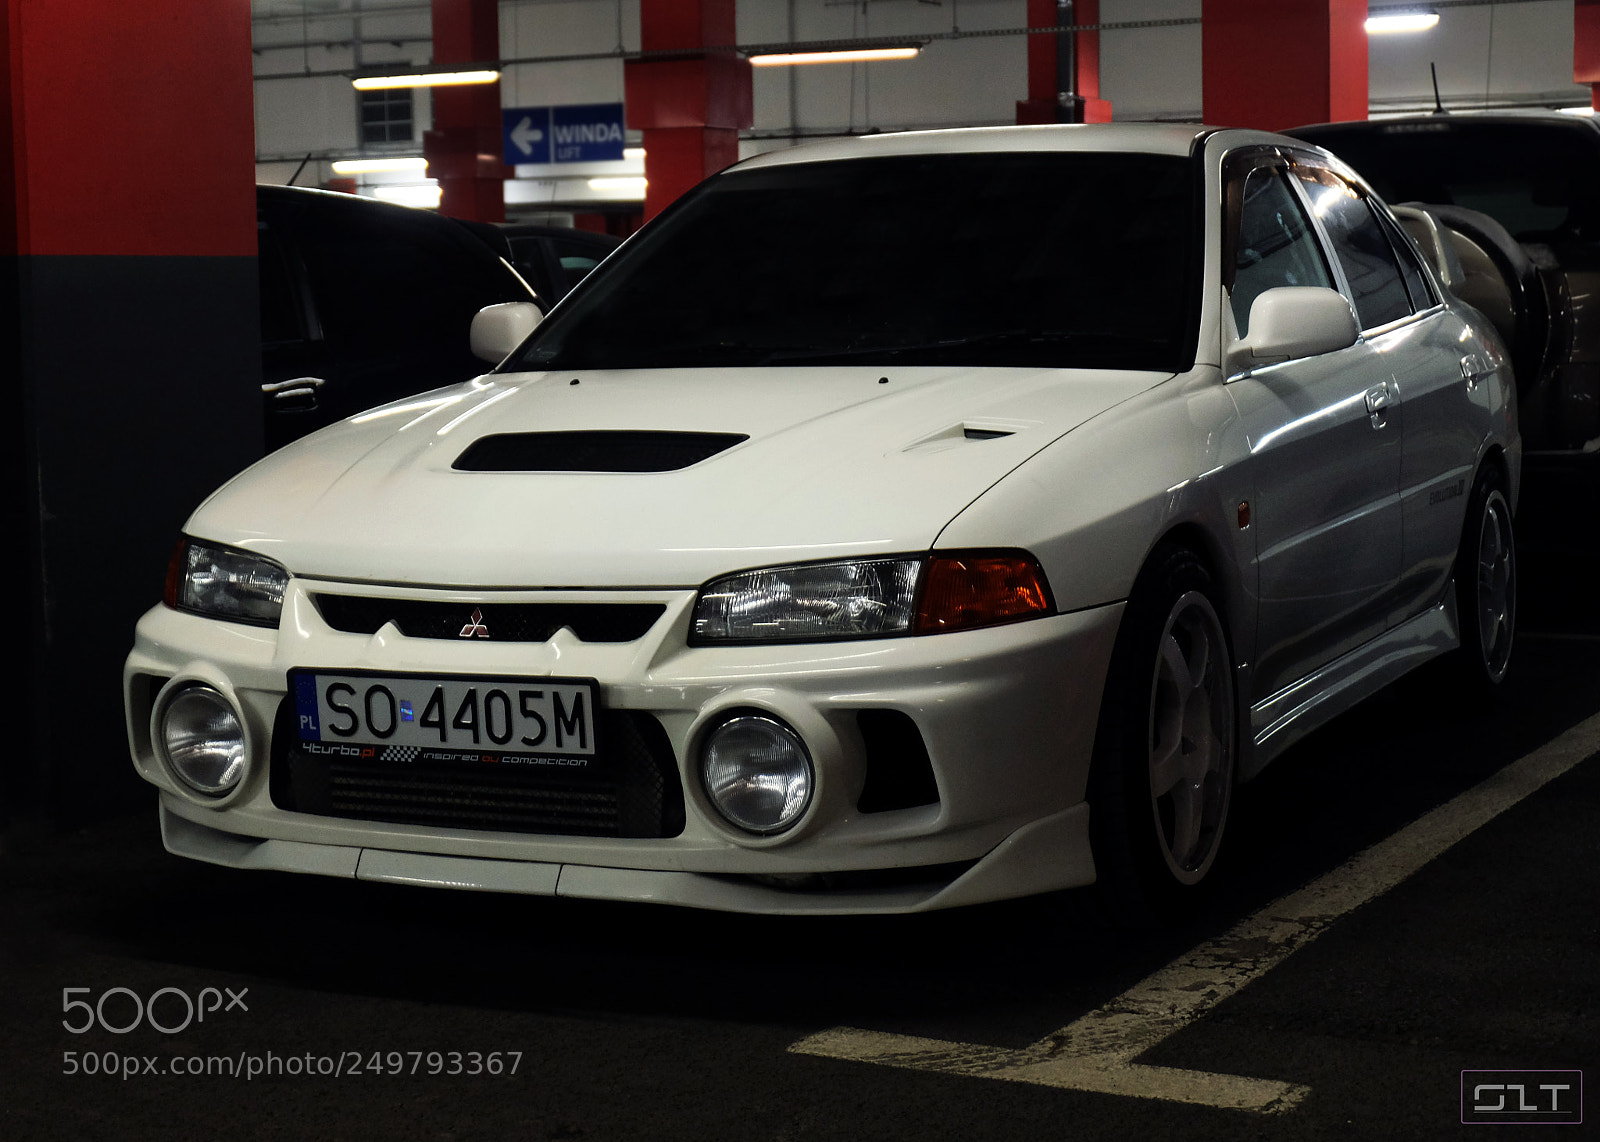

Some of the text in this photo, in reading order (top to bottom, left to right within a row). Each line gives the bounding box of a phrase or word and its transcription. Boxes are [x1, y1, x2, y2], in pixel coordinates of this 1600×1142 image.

[554, 122, 622, 144] WINDA
[558, 146, 581, 159] LIFT
[300, 714, 317, 731] PL
[325, 682, 588, 749] SO 4405M
[302, 741, 375, 760] 4turbo.pl
[423, 752, 479, 763] inspired
[502, 756, 588, 767] competition
